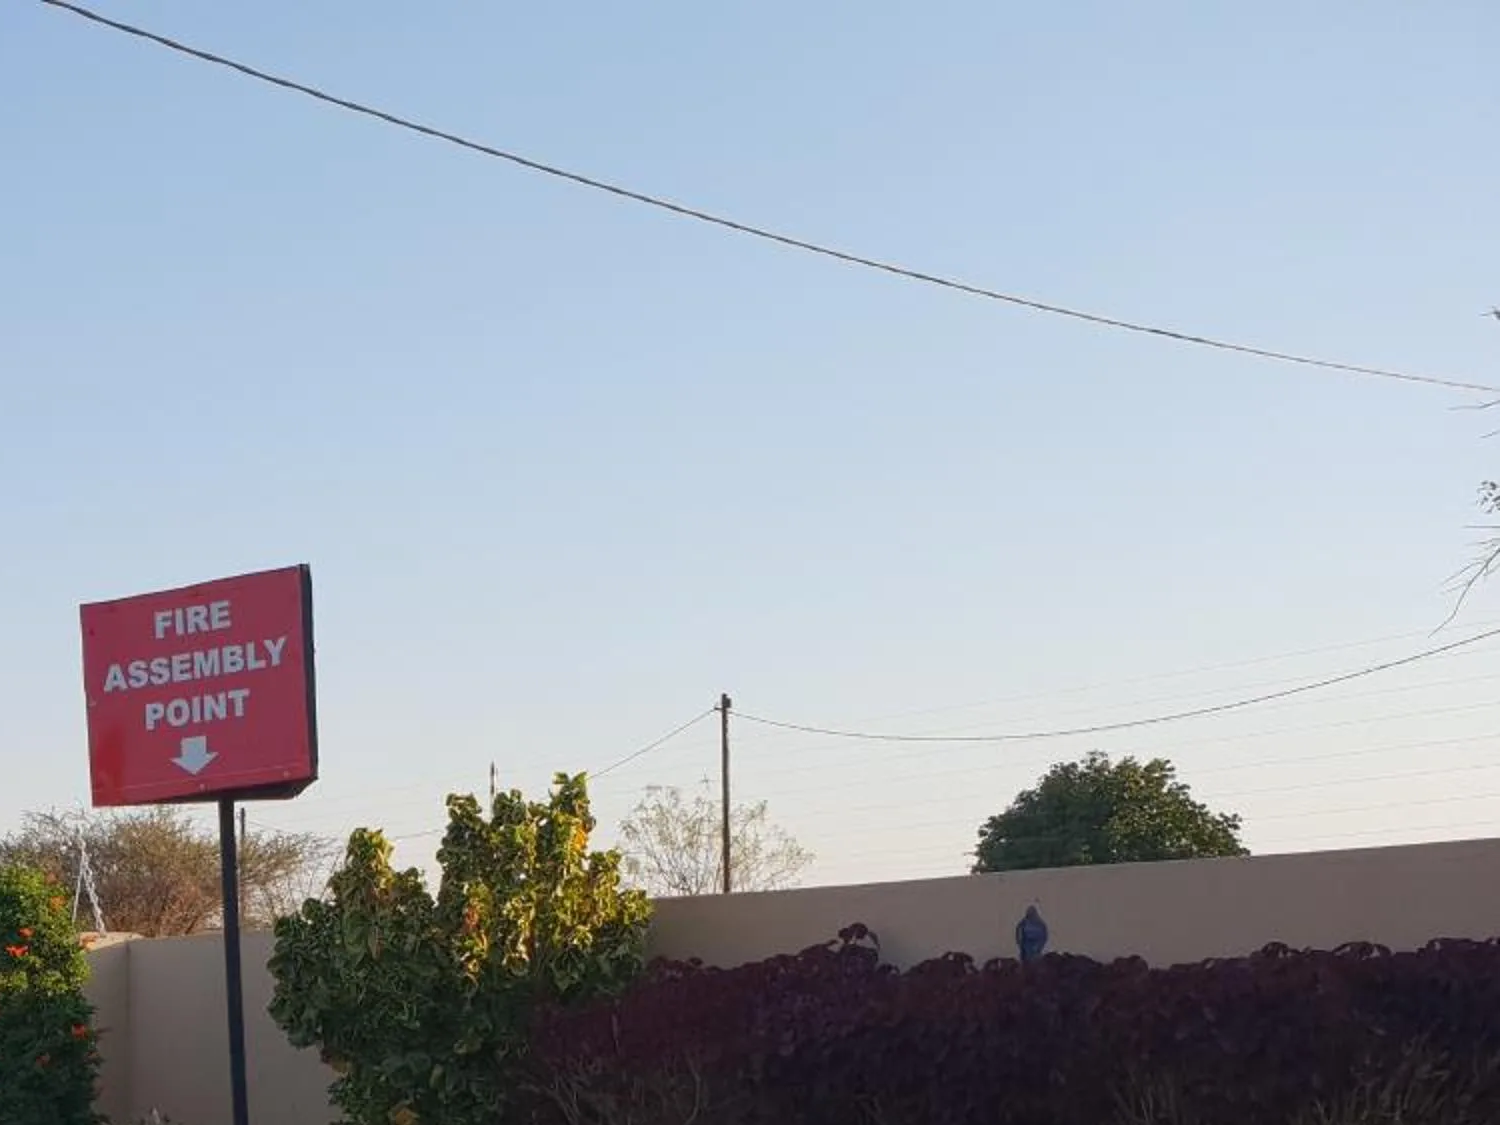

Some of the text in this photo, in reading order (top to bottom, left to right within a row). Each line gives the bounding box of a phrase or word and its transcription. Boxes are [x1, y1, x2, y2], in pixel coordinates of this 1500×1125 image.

[153, 600, 231, 639] FIRE
[103, 636, 287, 692] ASSEMBLY
[145, 688, 250, 730] POINT
